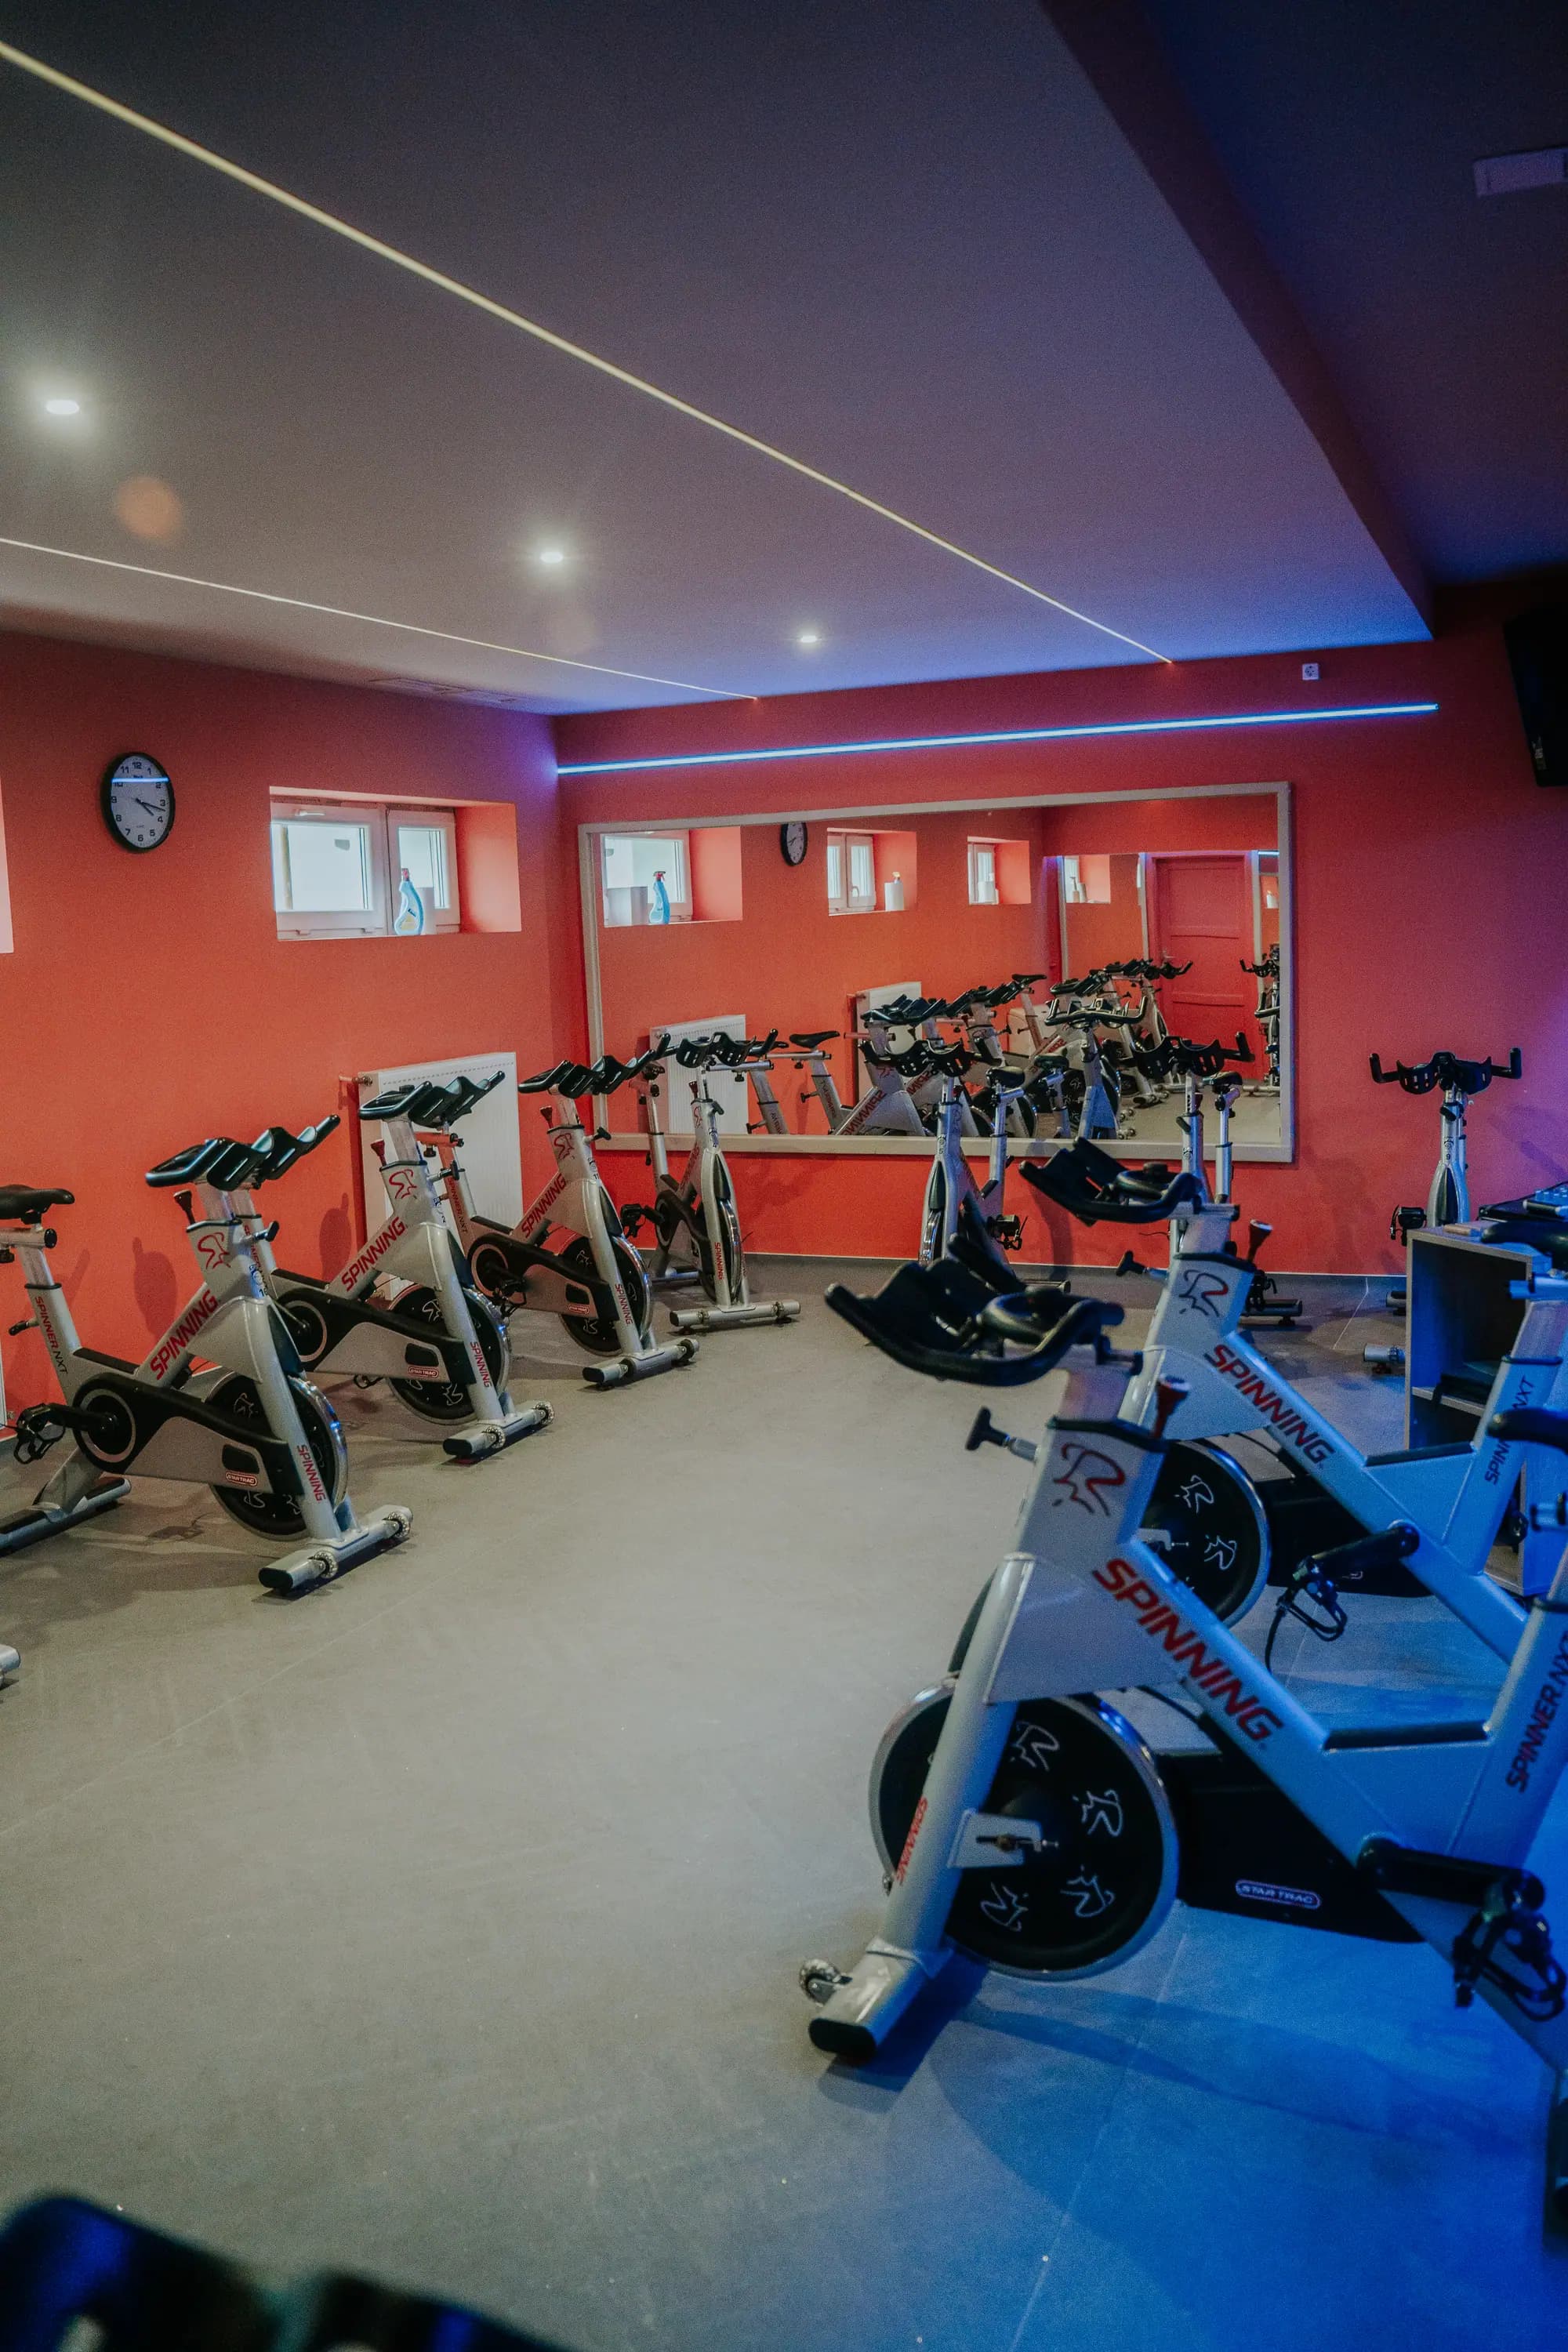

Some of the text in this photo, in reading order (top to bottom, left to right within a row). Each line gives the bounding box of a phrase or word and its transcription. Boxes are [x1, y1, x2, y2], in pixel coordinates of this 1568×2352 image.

[521, 1173, 567, 1238] SPINNING
[341, 1216, 406, 1292] SPINNING
[35, 1296, 68, 1374] SPINNER NXT
[150, 1289, 219, 1381] SPINNING
[614, 1283, 633, 1324] SPINNING
[470, 1341, 492, 1388] SPINNING
[1203, 1344, 1335, 1464] SPINNING
[297, 1444, 326, 1501] SPINNING
[1092, 1558, 1283, 1741] SPINNING
[1505, 1684, 1562, 1793] SPINNER
[1279, 1889, 1313, 1904] TRAC
